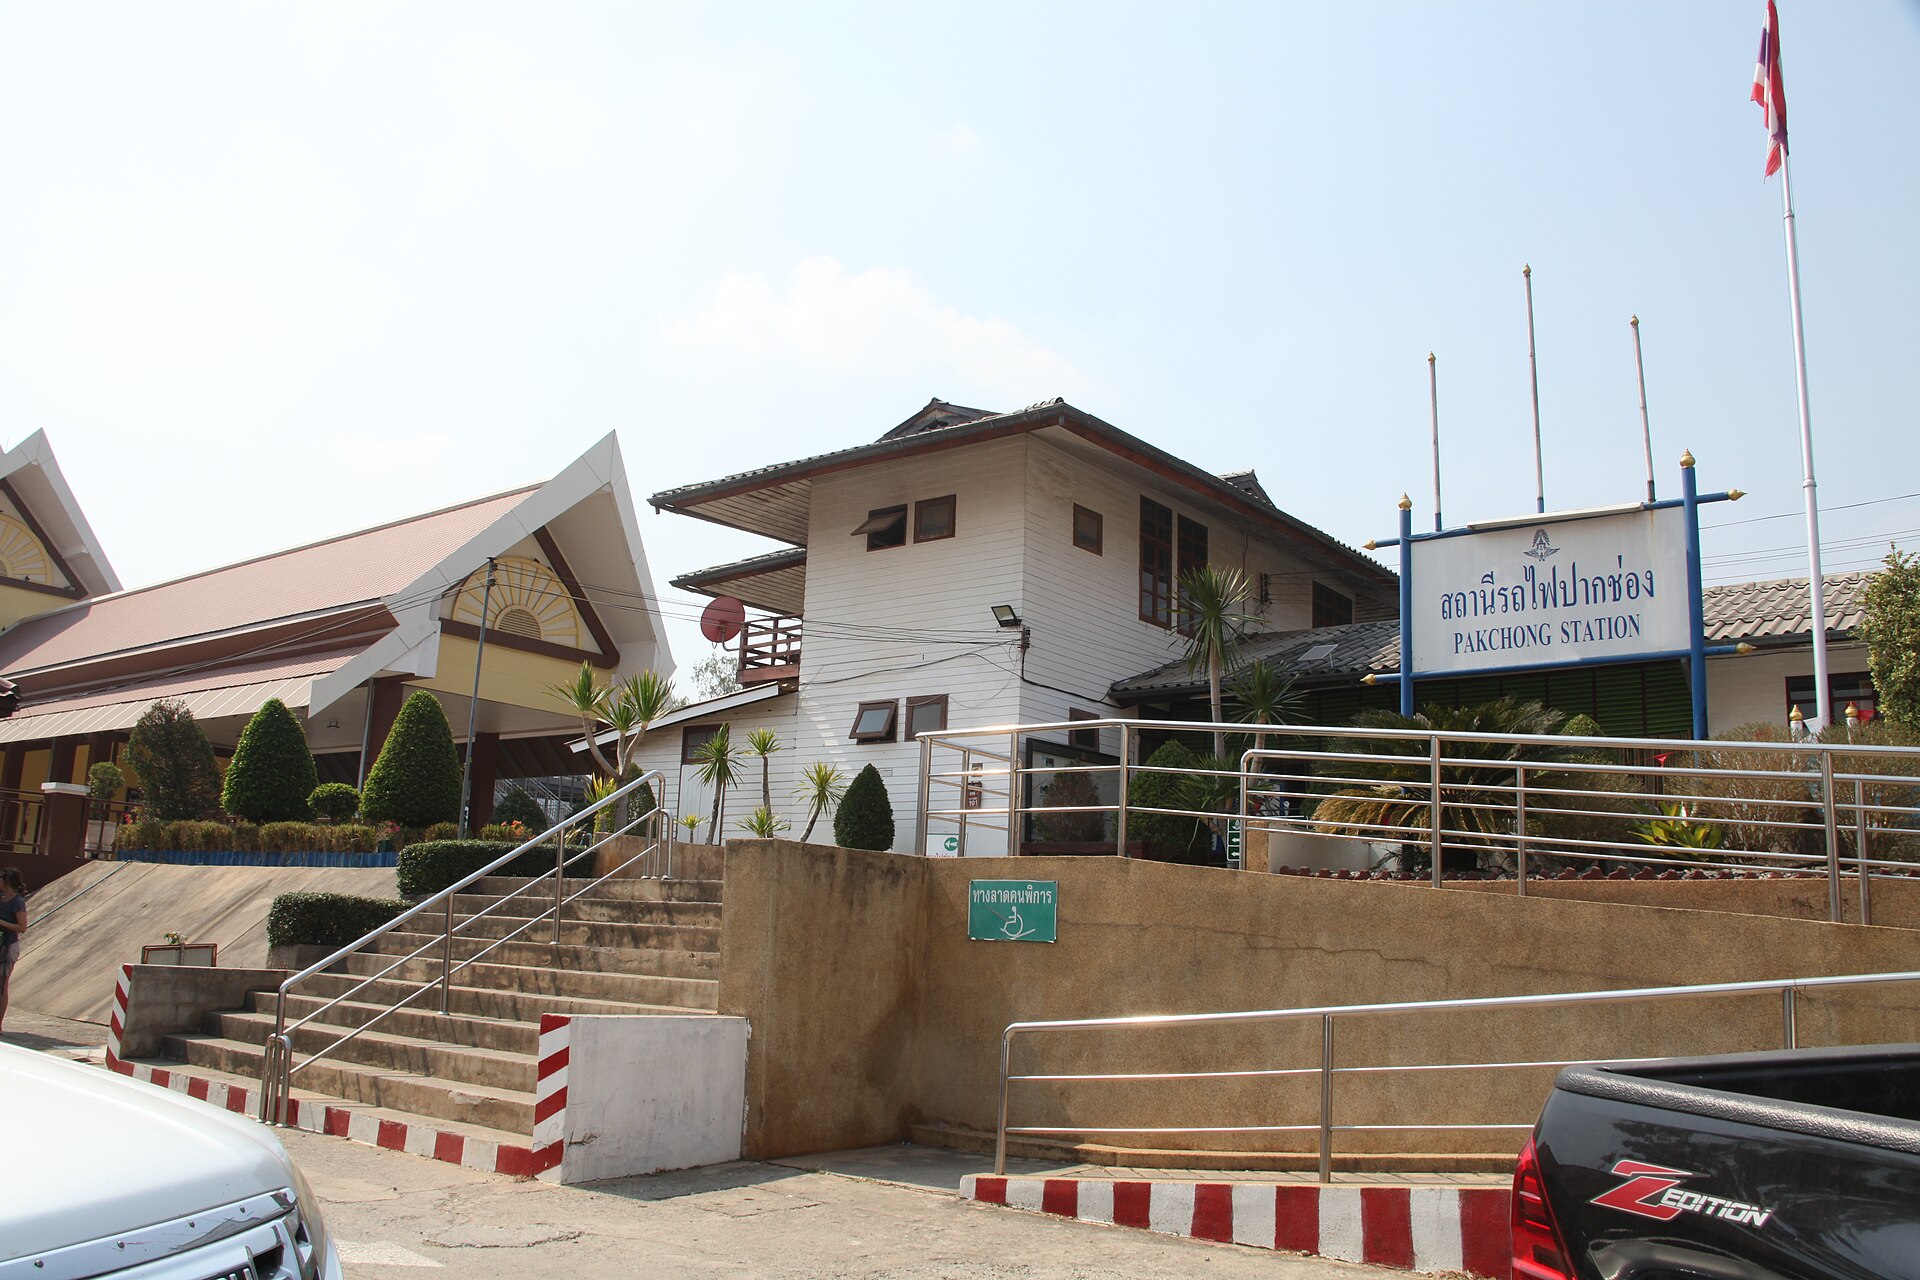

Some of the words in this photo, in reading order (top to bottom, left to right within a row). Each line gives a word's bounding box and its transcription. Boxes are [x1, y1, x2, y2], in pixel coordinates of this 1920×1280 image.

[1440, 555, 1655, 620] สถานีรถไฟปากช่อง
[1454, 622, 1551, 654] PAKCHONG
[1560, 613, 1641, 644] STATION
[973, 884, 1052, 904] ทางลาดคนพิการ
[1660, 1188, 1775, 1228] EDITION
